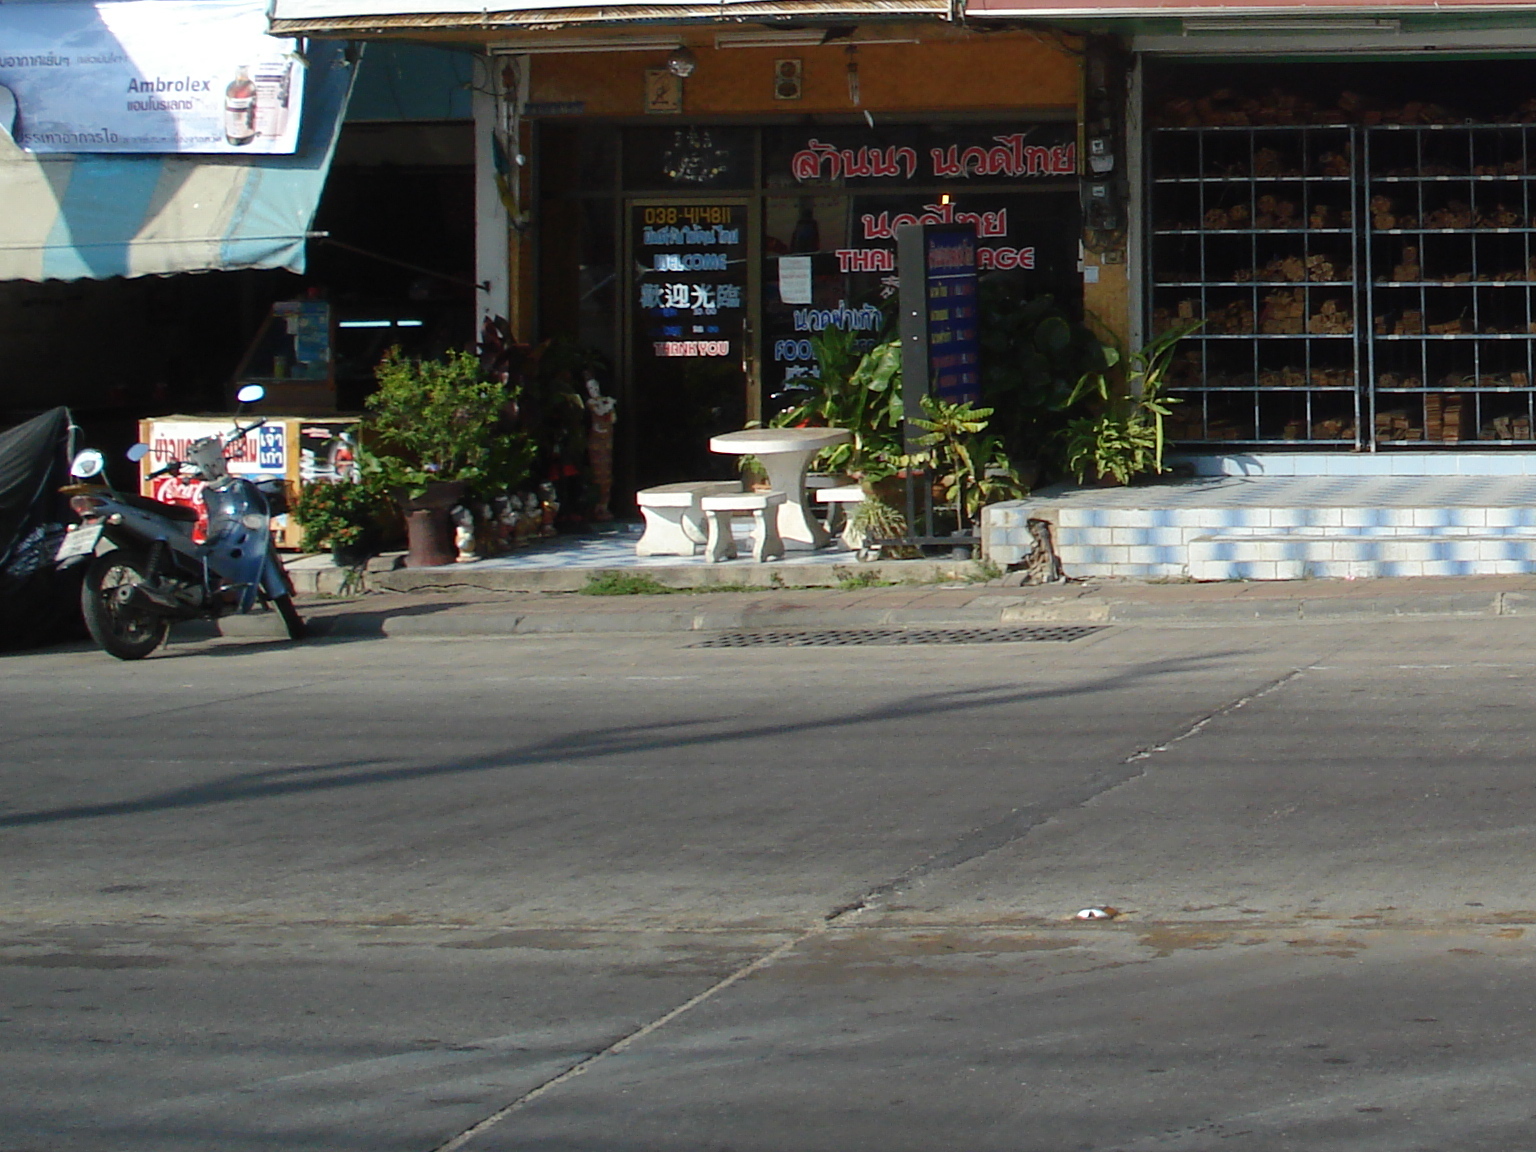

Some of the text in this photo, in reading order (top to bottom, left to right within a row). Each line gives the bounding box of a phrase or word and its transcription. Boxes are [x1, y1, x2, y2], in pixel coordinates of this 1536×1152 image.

[127, 77, 210, 93] Ambrolex
[792, 133, 1076, 182] ล้านนา นวดไทย
[644, 207, 731, 224] 038-414811
[653, 253, 727, 272] WELCOME
[836, 249, 894, 273] THAI
[640, 283, 741, 309] 歡迎光臨
[698, 341, 730, 356] YOU
